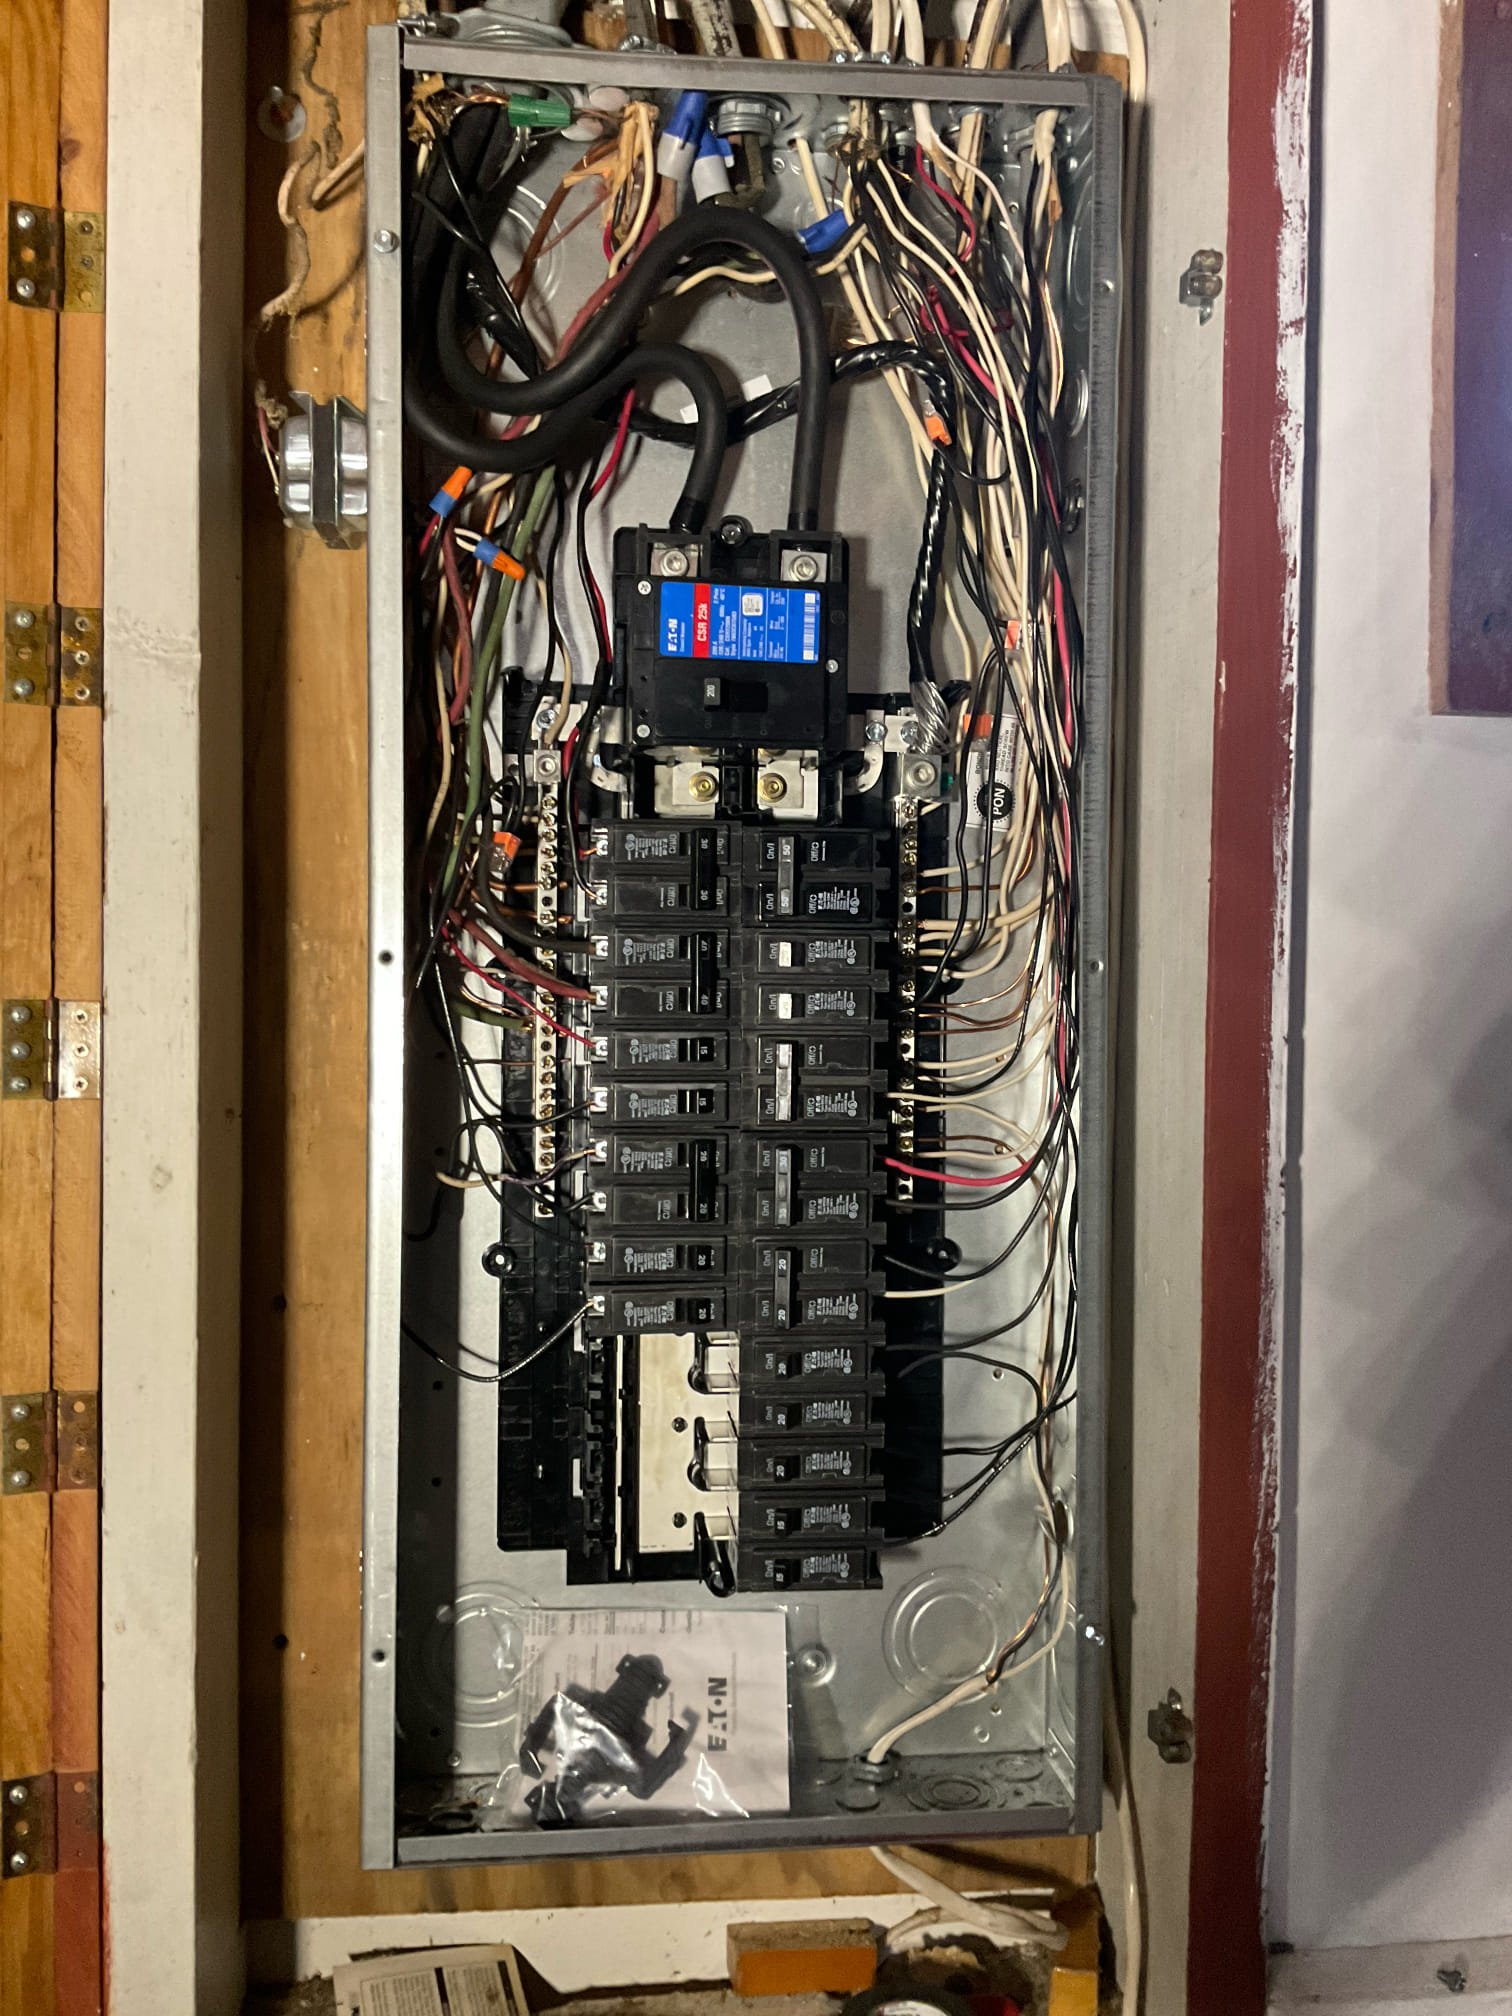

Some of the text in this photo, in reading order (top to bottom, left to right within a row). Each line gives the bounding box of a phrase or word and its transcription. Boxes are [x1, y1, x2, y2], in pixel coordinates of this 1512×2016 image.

[697, 622, 707, 642] CSR
[993, 788, 1005, 815] PON
[701, 838, 708, 850] 30
[767, 842, 775, 860] On/I
[782, 845, 790, 856] 50
[700, 890, 708, 901] 30
[766, 893, 774, 910] On/I
[781, 896, 789, 907] 50
[700, 994, 708, 1006] 40
[700, 1045, 708, 1055] 15
[765, 1048, 774, 1064] On/I
[699, 1097, 707, 1107] 15
[765, 1098, 774, 1114] On/I
[698, 1254, 706, 1266] 20
[779, 1258, 786, 1270] 20
[698, 1308, 706, 1320] 20
[778, 1309, 786, 1320] 20
[778, 1363, 786, 1375] 20
[778, 1414, 785, 1425] 20
[776, 1465, 785, 1477] 20
[777, 1520, 785, 1530] 15
[776, 1572, 784, 1582] 15
